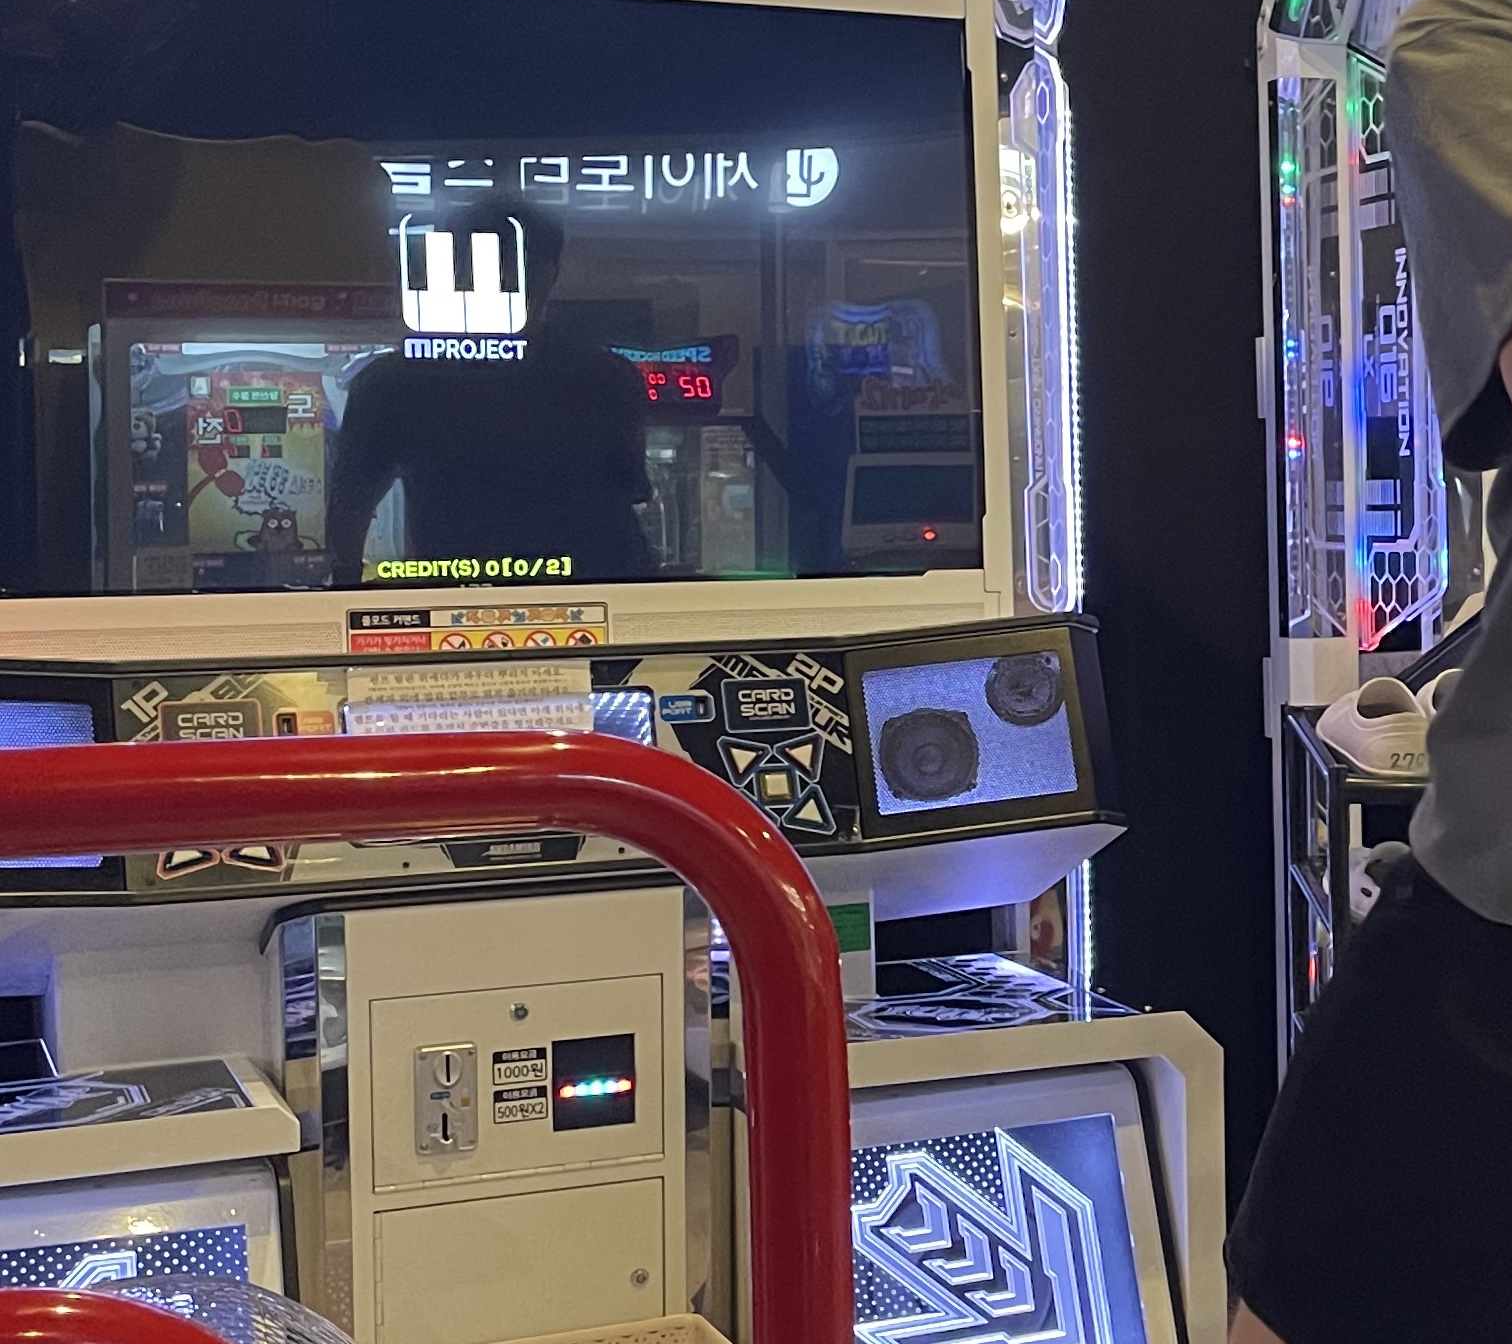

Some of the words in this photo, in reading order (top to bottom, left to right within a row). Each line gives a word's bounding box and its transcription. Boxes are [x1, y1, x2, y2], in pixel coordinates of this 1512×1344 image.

[1379, 304, 1398, 404] 016
[1394, 248, 1411, 457] INNOVATION
[377, 557, 481, 579] CREDIT(S)
[787, 653, 845, 695] 2P
[121, 681, 169, 723] 1P
[738, 688, 794, 702] CARD
[177, 712, 243, 727] CARD
[740, 702, 796, 717] SCAN
[497, 1062, 544, 1080] 1000원
